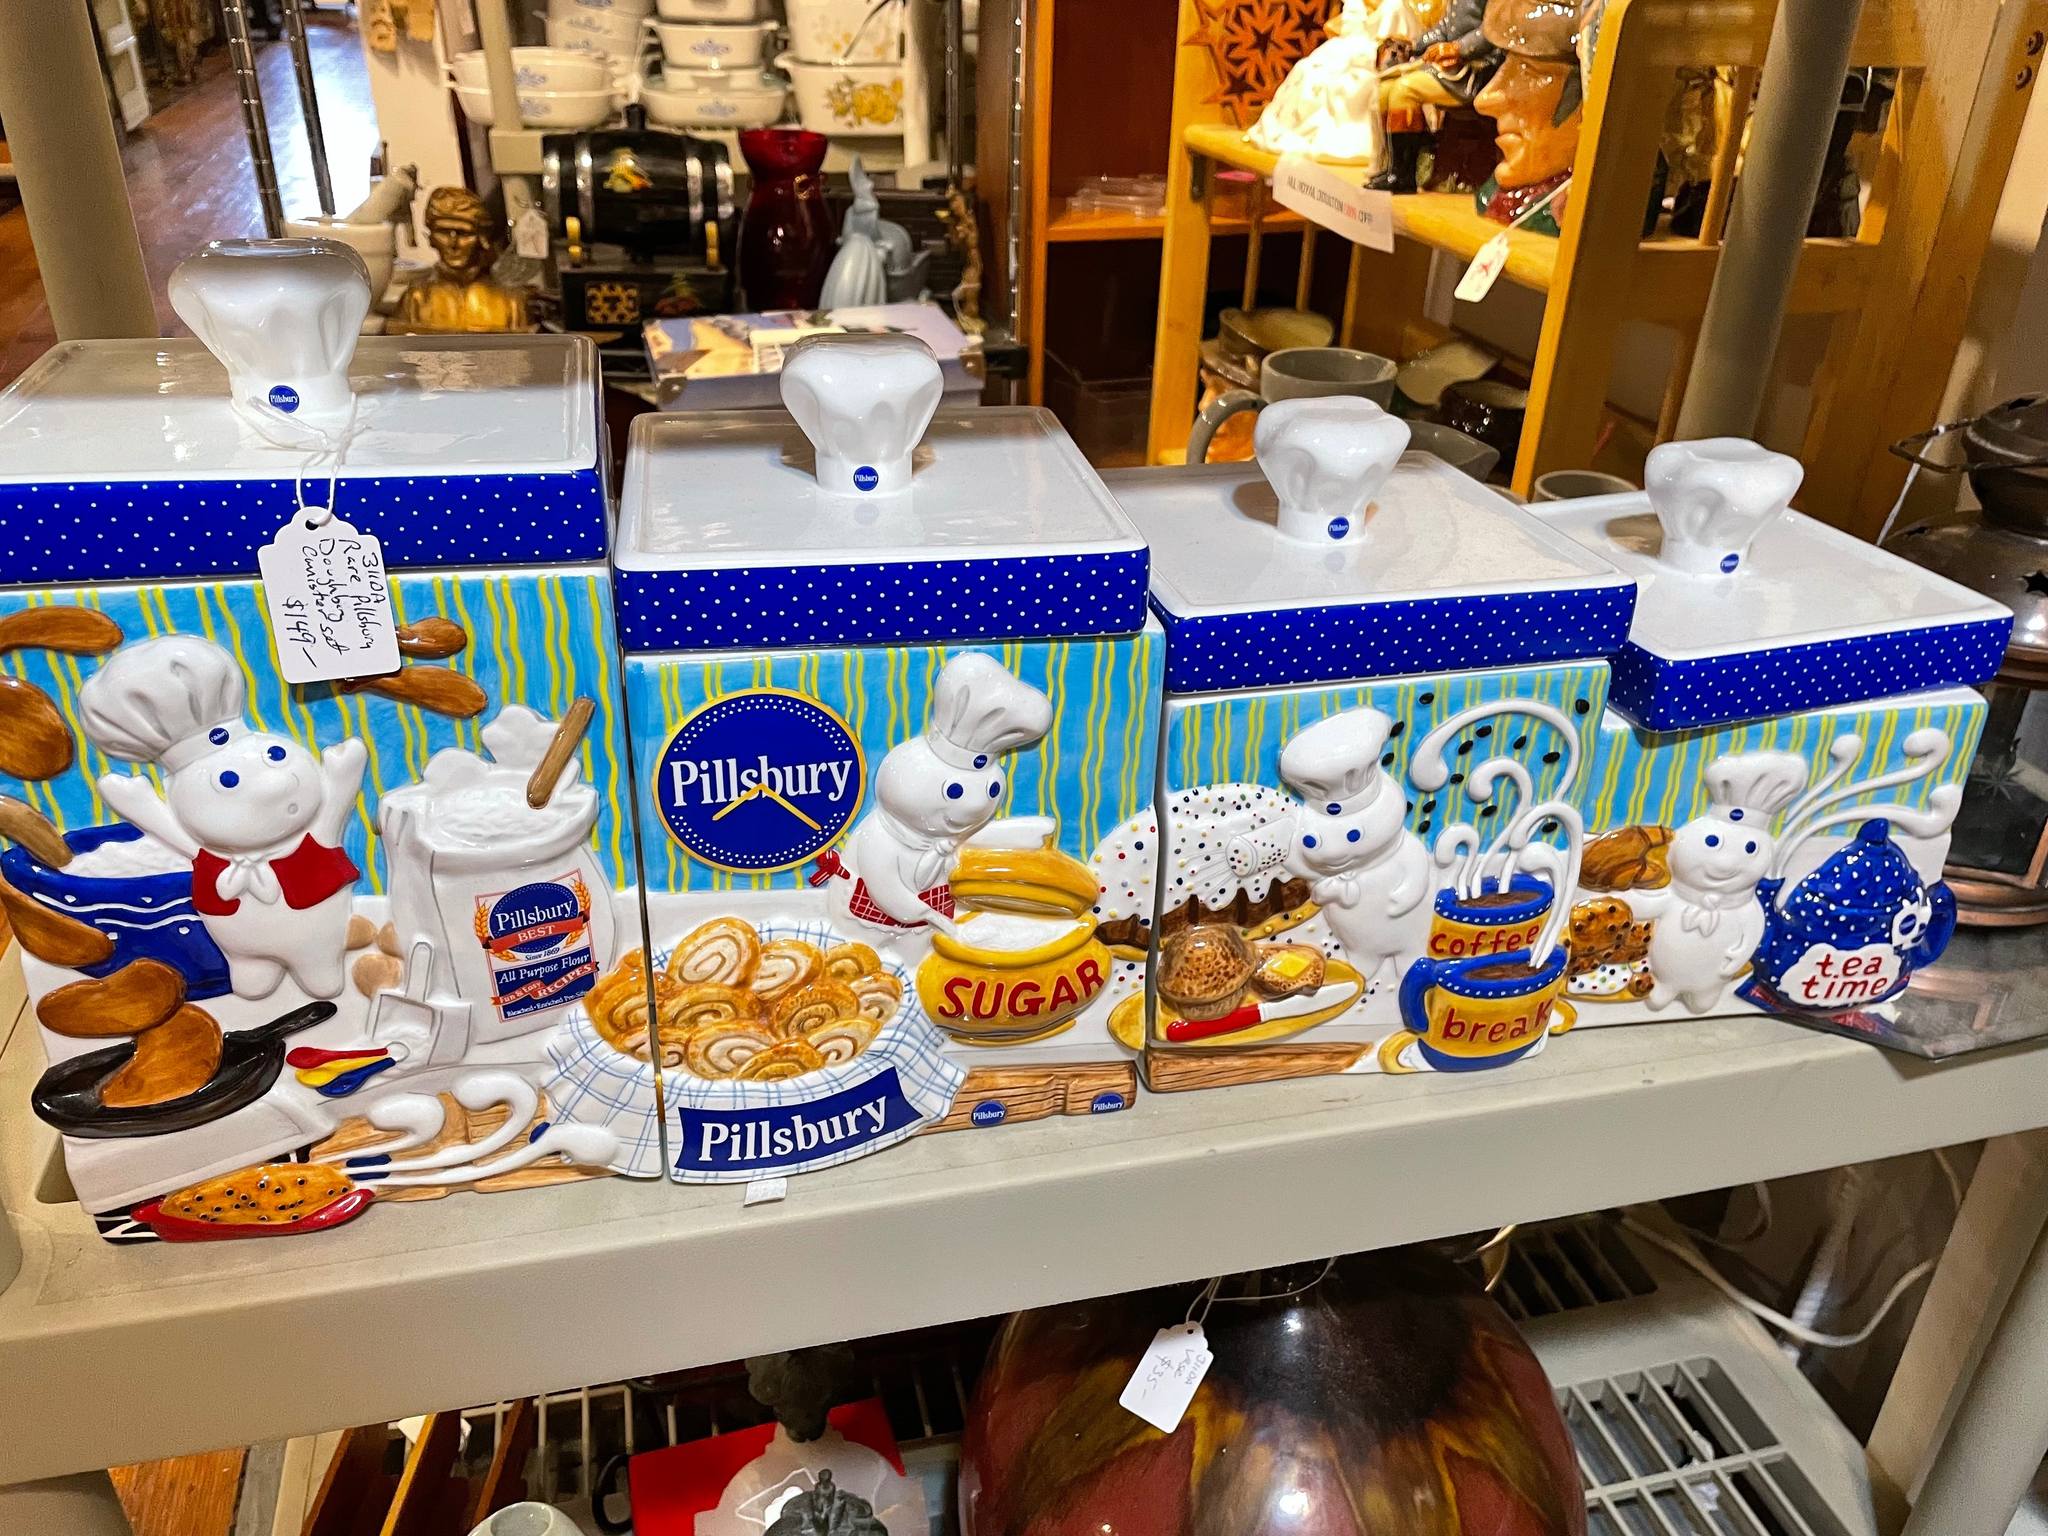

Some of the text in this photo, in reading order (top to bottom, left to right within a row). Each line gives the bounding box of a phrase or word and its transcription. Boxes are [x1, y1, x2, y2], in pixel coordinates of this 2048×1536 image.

[270, 394, 299, 404] Pillsbury
[338, 539, 382, 649] Rare Pillsbury
[670, 755, 853, 807] Pillsbury
[495, 900, 573, 932] Pillsbury
[518, 924, 556, 943] BEST
[1430, 924, 1540, 953] coffee
[543, 947, 560, 958] 1869
[1816, 953, 1883, 980] tea
[498, 953, 590, 985] All Purpose Flour
[499, 994, 515, 1004] Fun
[538, 963, 592, 998] RECIPES
[938, 959, 1104, 1019] SUGAR
[1801, 975, 1888, 1001] time
[973, 1109, 1006, 1121] Pillsbury
[1093, 1102, 1123, 1112] Pillsbury
[699, 1096, 887, 1163] Pillsbury
